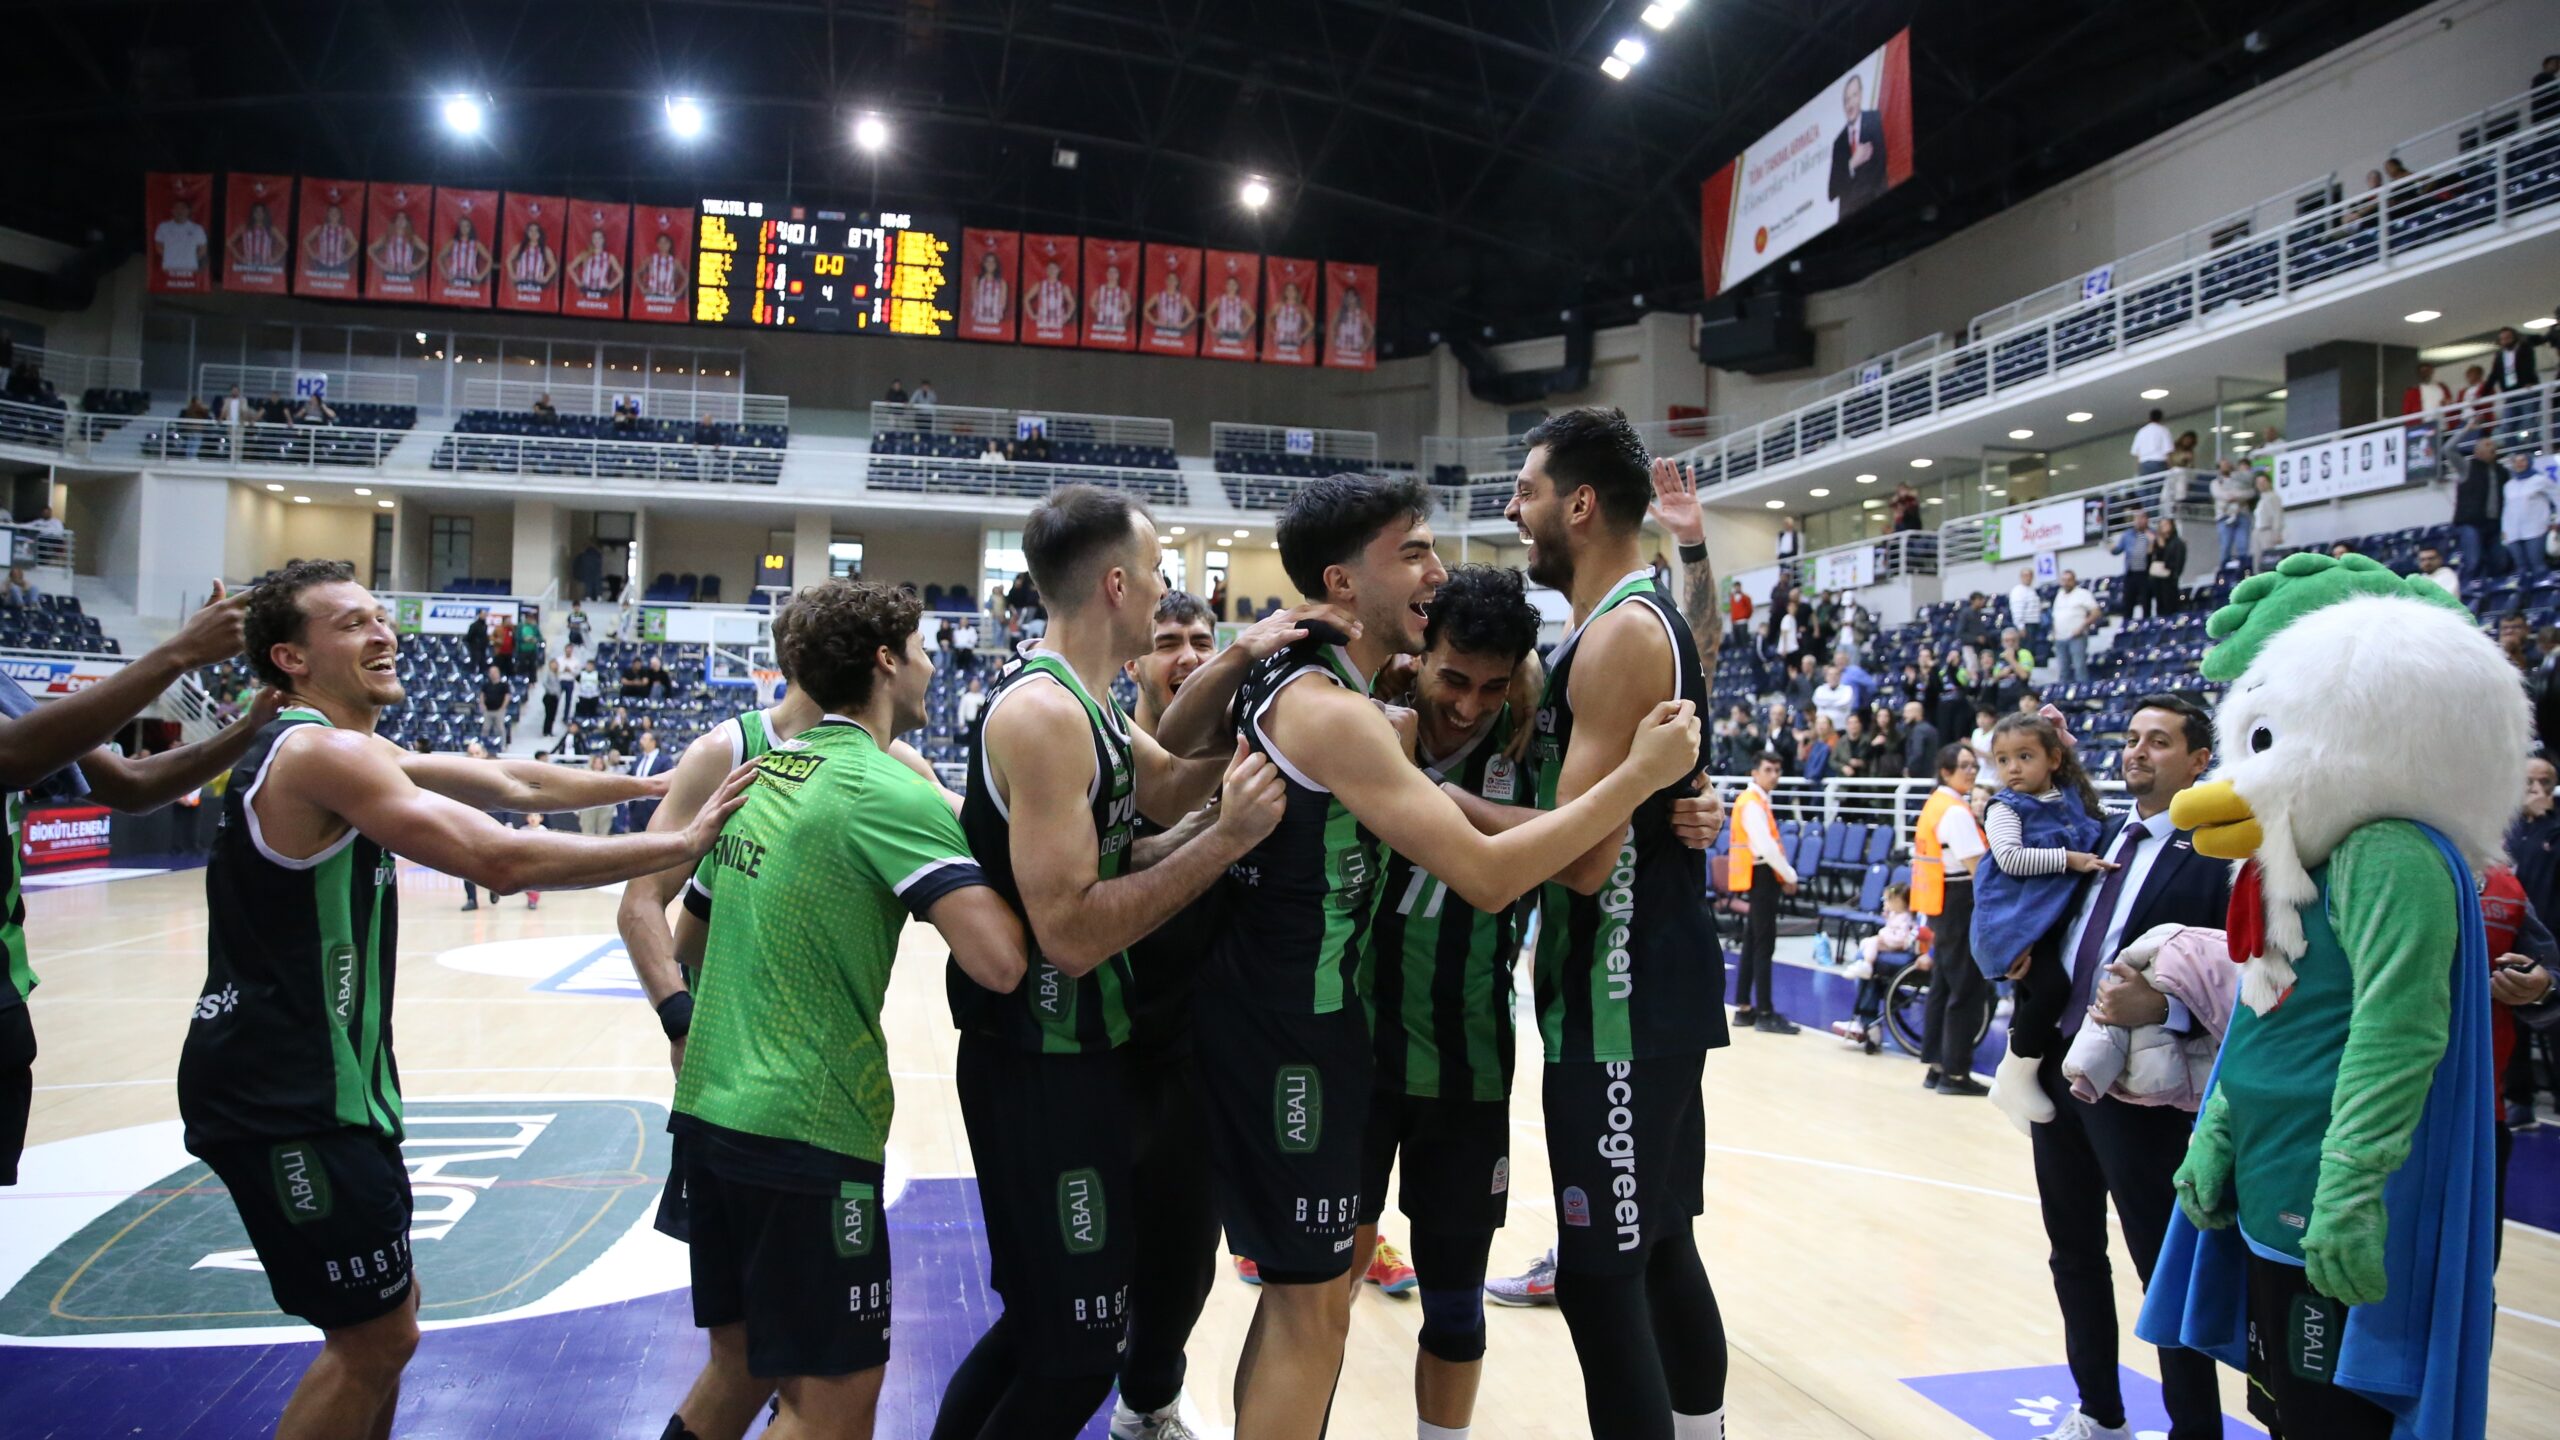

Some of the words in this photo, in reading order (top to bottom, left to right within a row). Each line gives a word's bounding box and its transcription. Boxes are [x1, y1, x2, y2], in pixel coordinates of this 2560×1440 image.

[297, 378, 325, 397] H2
[1287, 430, 1311, 450] H5
[2280, 436, 2397, 489] BOSTON
[0, 663, 51, 679] UKA
[336, 954, 353, 1017] ABALI
[1287, 1075, 1307, 1143] ABALI
[281, 1151, 317, 1211] ABALI
[1597, 1060, 1641, 1252] ecogreen
[844, 1199, 863, 1245] ABA
[1068, 1179, 1094, 1243] ABALI
[1295, 1193, 1361, 1224] BOST
[2303, 1304, 2325, 1371] ABALI
